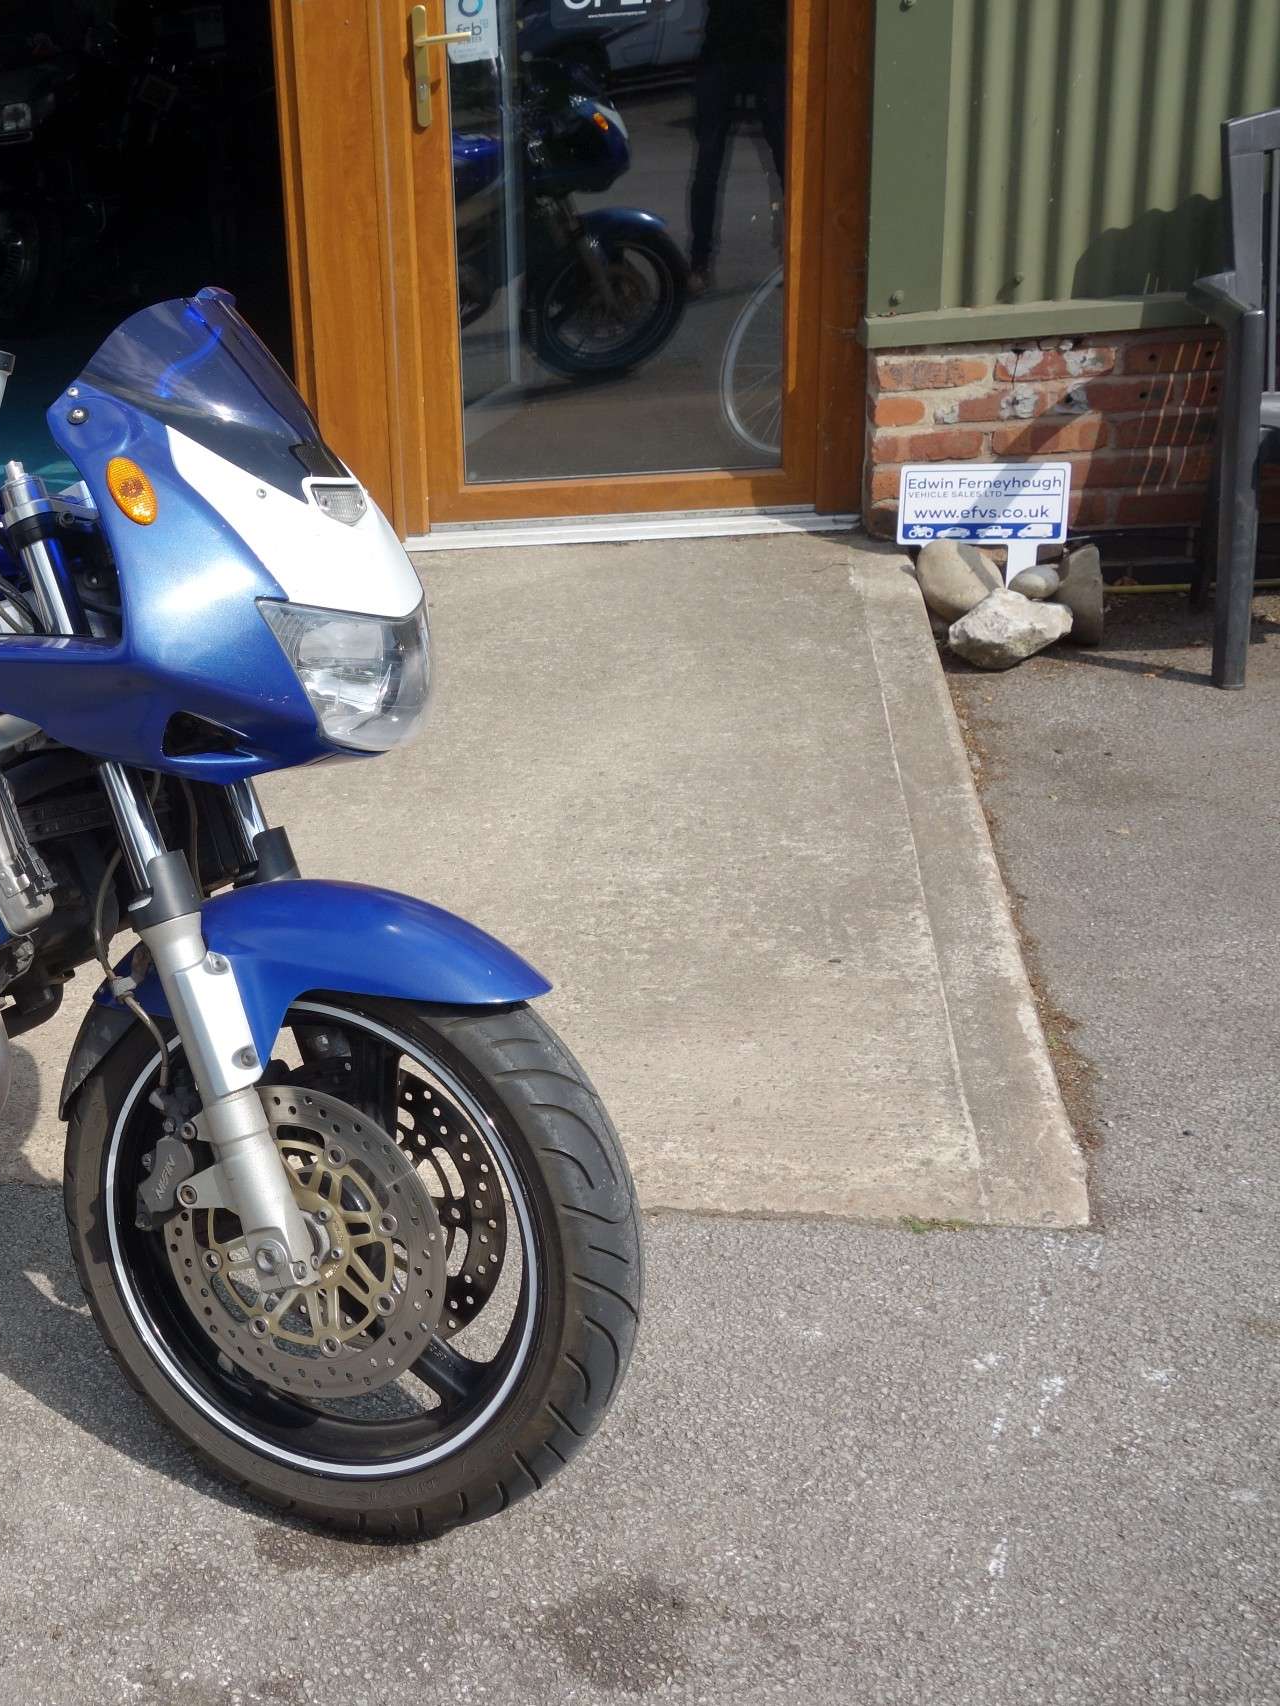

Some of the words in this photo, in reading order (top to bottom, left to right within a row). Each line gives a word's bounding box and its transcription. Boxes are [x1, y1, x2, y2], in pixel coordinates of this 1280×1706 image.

[908, 478, 953, 489] Edwin
[959, 476, 1061, 491] Ferneyhough
[909, 491, 949, 499] VEHICLE
[951, 490, 983, 498] SALES
[914, 505, 1049, 519] www.efvs.co.uk
